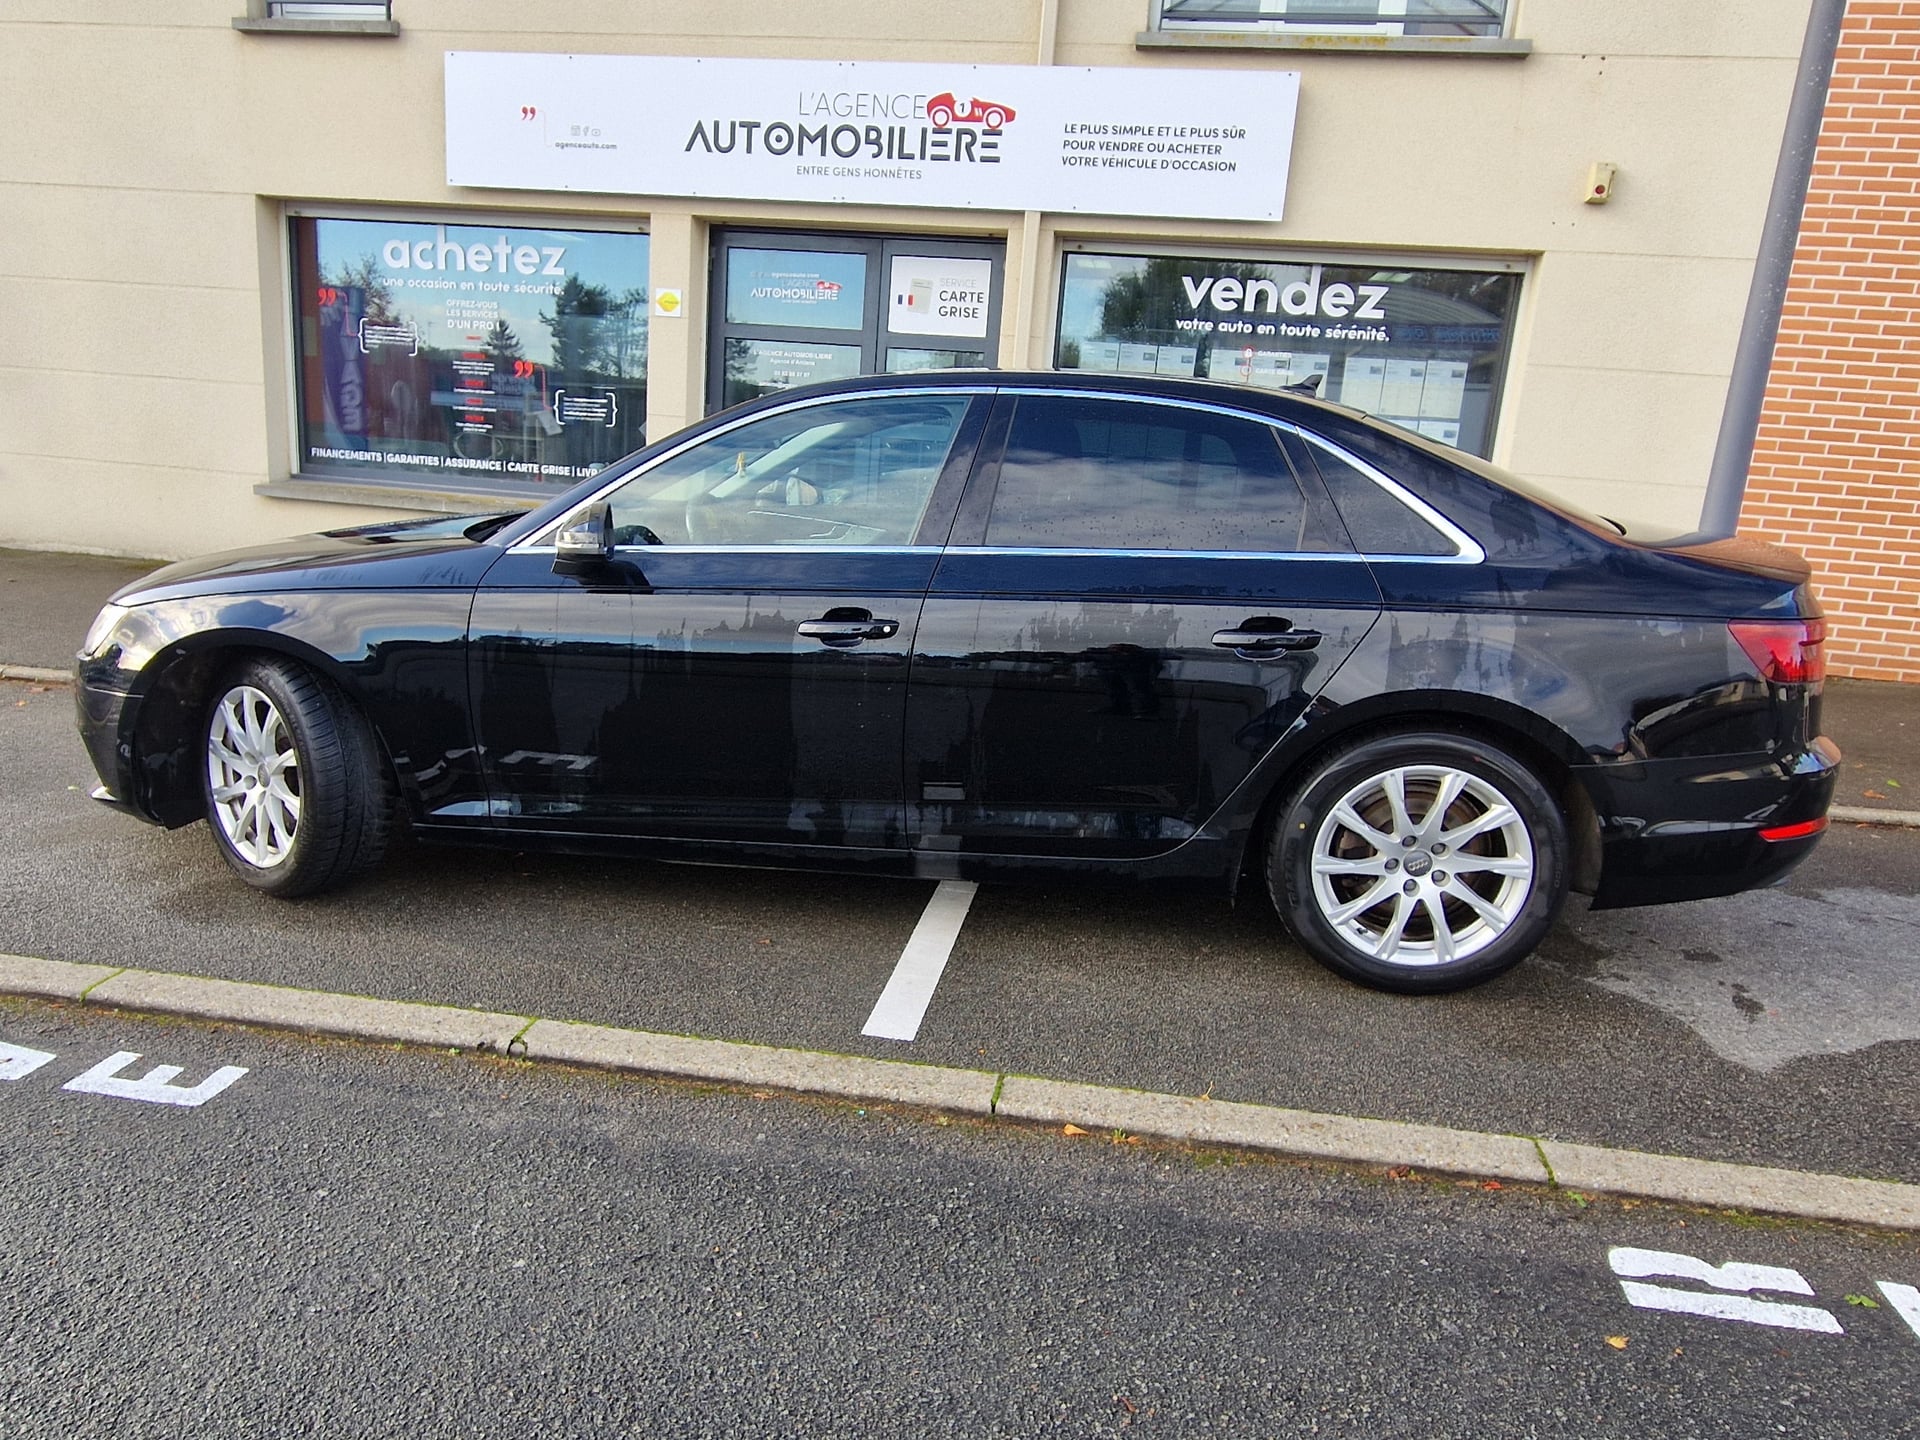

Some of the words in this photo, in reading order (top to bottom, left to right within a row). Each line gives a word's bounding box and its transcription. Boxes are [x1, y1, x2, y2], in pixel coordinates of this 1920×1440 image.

[798, 92, 927, 119] L'AGENCE
[1064, 123, 1077, 134] LE
[1080, 124, 1109, 135] PLUS
[1111, 125, 1154, 137] SIMPLE
[1157, 126, 1171, 137] ET
[1174, 127, 1187, 137] LE
[1189, 127, 1219, 138] PLUS
[1222, 125, 1246, 139] SÛR
[555, 142, 617, 150] agenceauto.com
[1063, 140, 1096, 151] POUR
[1099, 141, 1144, 152] VENDRE
[1147, 142, 1165, 153] OU
[1166, 143, 1222, 155] ACHETER
[1062, 156, 1098, 167] VOTRE
[1101, 154, 1158, 169] VÉHICULE
[1160, 159, 1237, 172] D'OCCASION
[796, 165, 830, 176] ENTRE
[832, 167, 862, 178] GENS
[864, 165, 923, 179] HONNÊTES
[383, 225, 566, 276] achetez
[383, 278, 404, 287] une
[408, 277, 457, 290] occasion
[460, 282, 475, 291] en
[479, 281, 510, 293] toute
[514, 281, 565, 296] sécurité.
[940, 278, 977, 288] SERVICE
[939, 290, 984, 303] CARTE
[1181, 264, 1390, 319] vendez
[446, 299, 498, 309] OFFREZ-VOUS
[446, 309, 461, 317] LES
[462, 310, 499, 319] SERVICES
[938, 305, 980, 319] GRISE
[447, 319, 471, 329] D'UN
[473, 321, 495, 330] PRO
[1175, 318, 1214, 332] votre
[1217, 320, 1253, 334] auto
[1256, 324, 1276, 335] en
[1280, 323, 1321, 338] toute
[1325, 323, 1390, 342] sérénité.
[311, 447, 382, 462] FINANCEMENTS
[386, 453, 440, 466] GARANTIES
[444, 458, 502, 471] ASSURANCE
[507, 462, 540, 474] CARTE
[540, 465, 571, 476] GRISE
